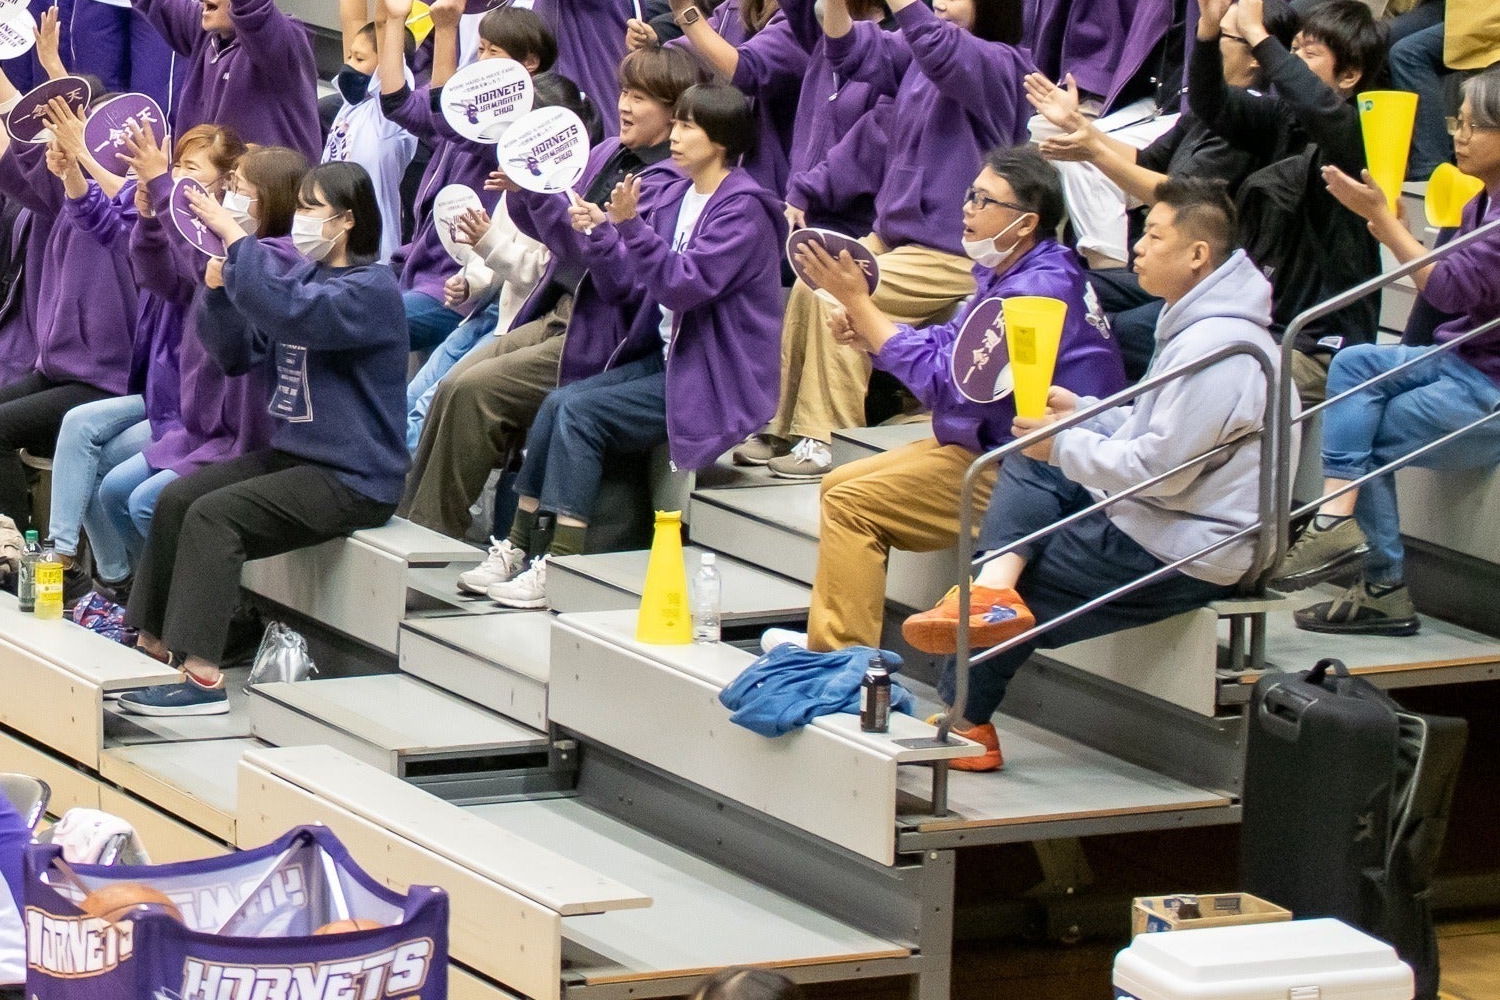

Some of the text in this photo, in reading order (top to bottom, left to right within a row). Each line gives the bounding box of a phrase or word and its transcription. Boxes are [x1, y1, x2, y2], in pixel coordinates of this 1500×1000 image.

[475, 80, 525, 105] HORNETS
[480, 92, 523, 112] YAMAGATA
[13, 87, 83, 124] 一念天
[494, 104, 514, 117] CHUO
[532, 124, 578, 156] HORNETS
[554, 149, 573, 165] CHUO
[180, 937, 436, 1000] HORNETS
